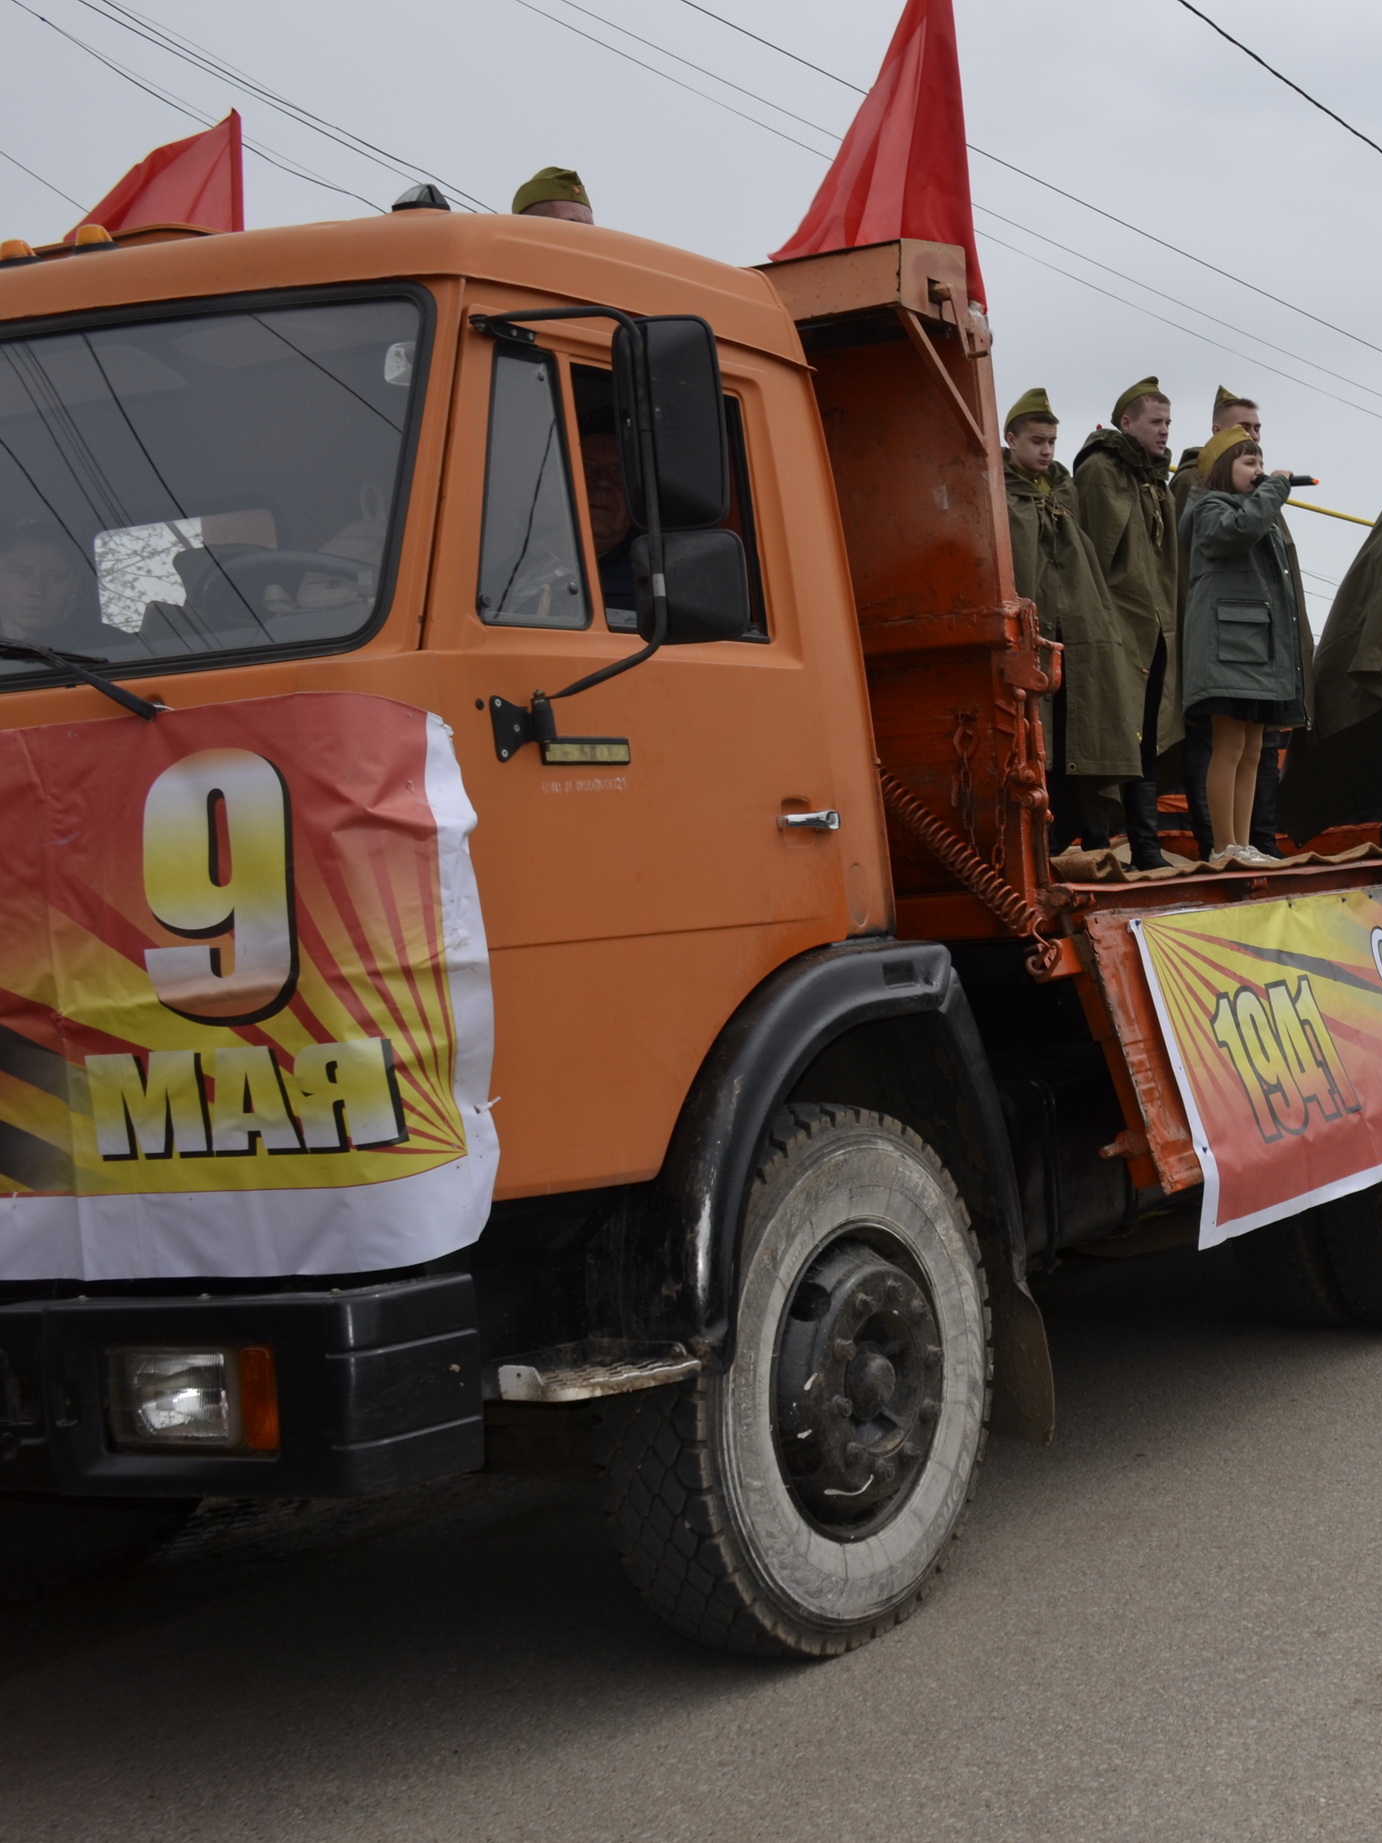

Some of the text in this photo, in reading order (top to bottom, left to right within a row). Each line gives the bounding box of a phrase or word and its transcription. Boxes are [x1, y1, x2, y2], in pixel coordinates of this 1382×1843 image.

[143, 748, 298, 1027] 9
[85, 1037, 409, 1161] МАЯ
[1211, 974, 1362, 1144] 1941
